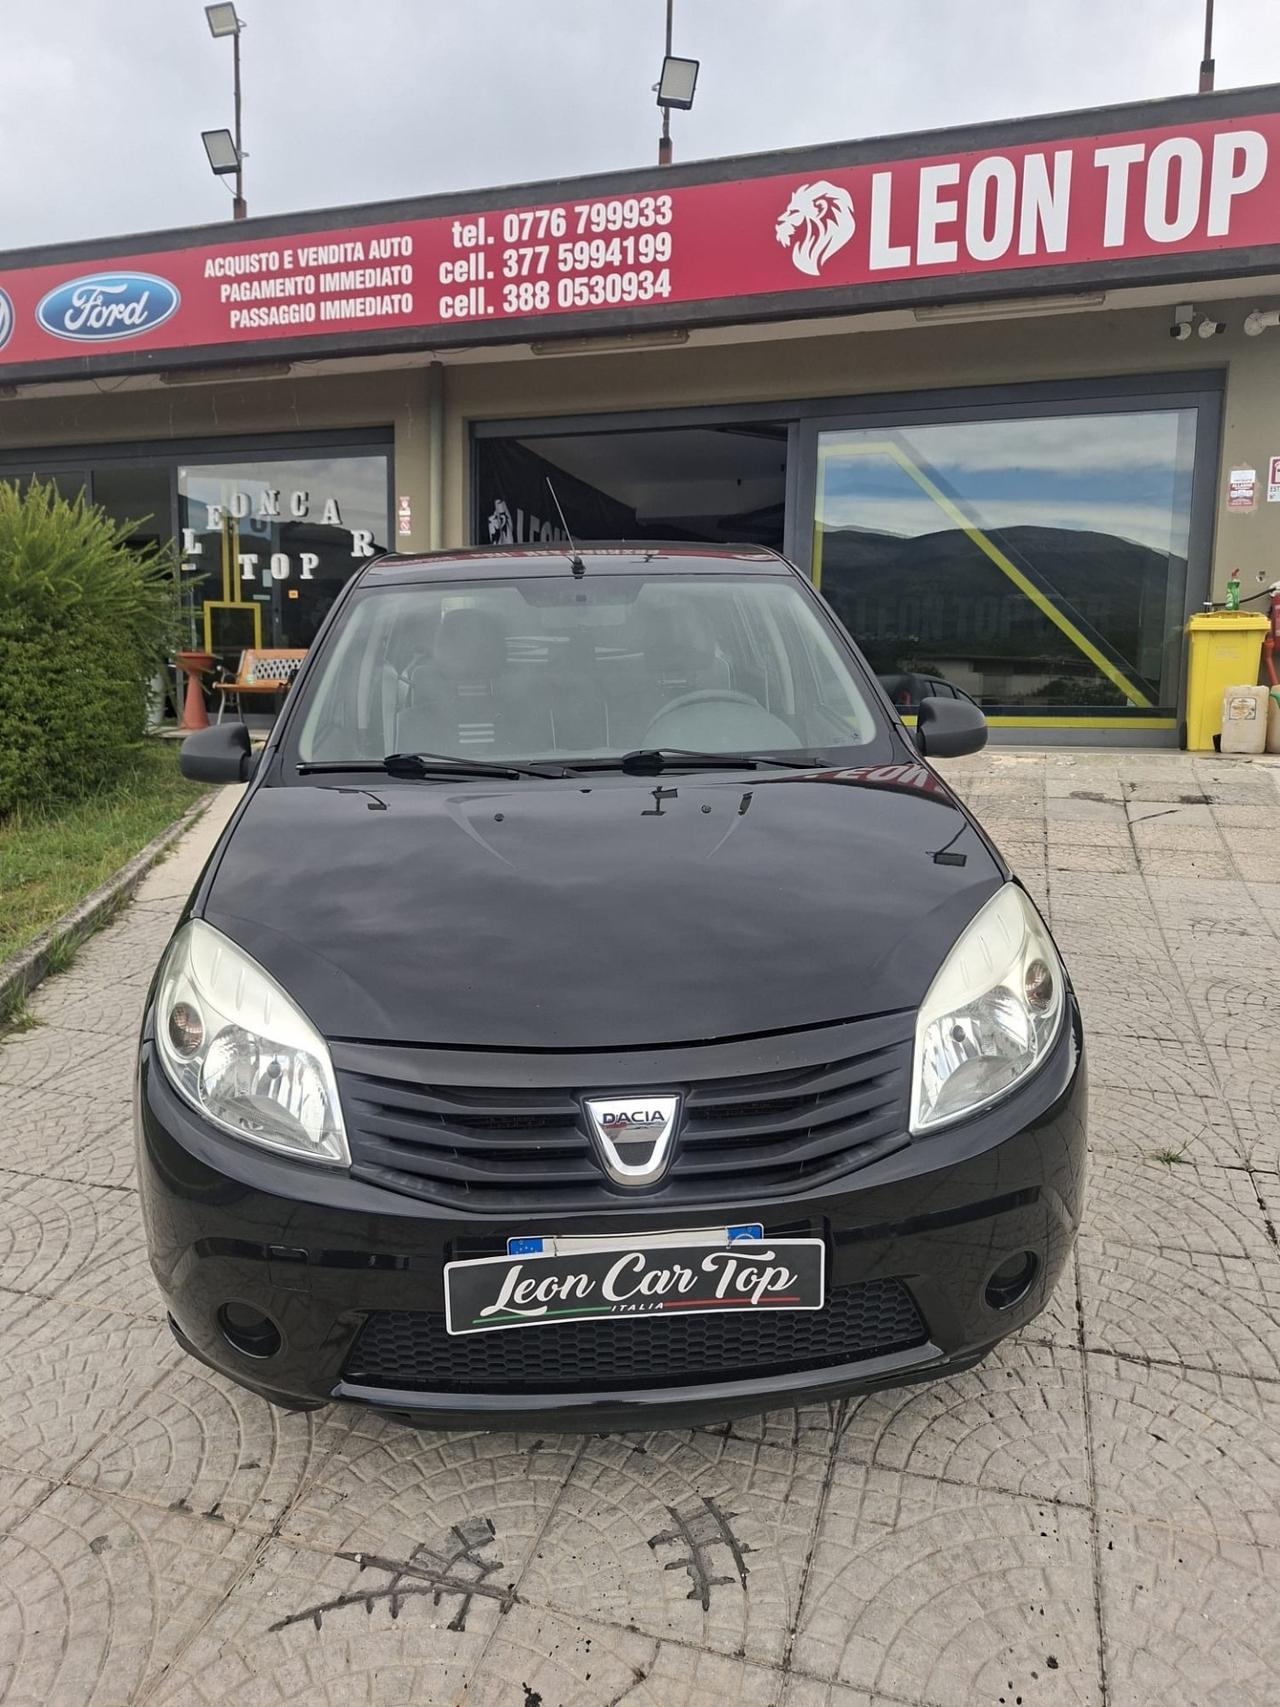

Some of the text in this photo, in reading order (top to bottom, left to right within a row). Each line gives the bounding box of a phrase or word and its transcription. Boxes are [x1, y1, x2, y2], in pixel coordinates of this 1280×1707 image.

[451, 195, 673, 248] tel. 0776 799933
[868, 130, 1268, 271] LEON TOP
[204, 235, 413, 278] ACQUISTO E VENDITA AUTO
[438, 231, 672, 284] cell. 377 5994199
[219, 264, 413, 303] PAGAMENTO IMMEDIATO
[438, 268, 672, 319] cell. 388 0530934
[63, 283, 150, 331] Ford
[229, 292, 413, 329] PASSAGGIO IMMEDIATO
[238, 552, 319, 580] TOP
[602, 1110, 665, 1125] DACIA
[479, 1250, 798, 1317] Leon Car Top
[611, 1302, 664, 1312] ITALIA
